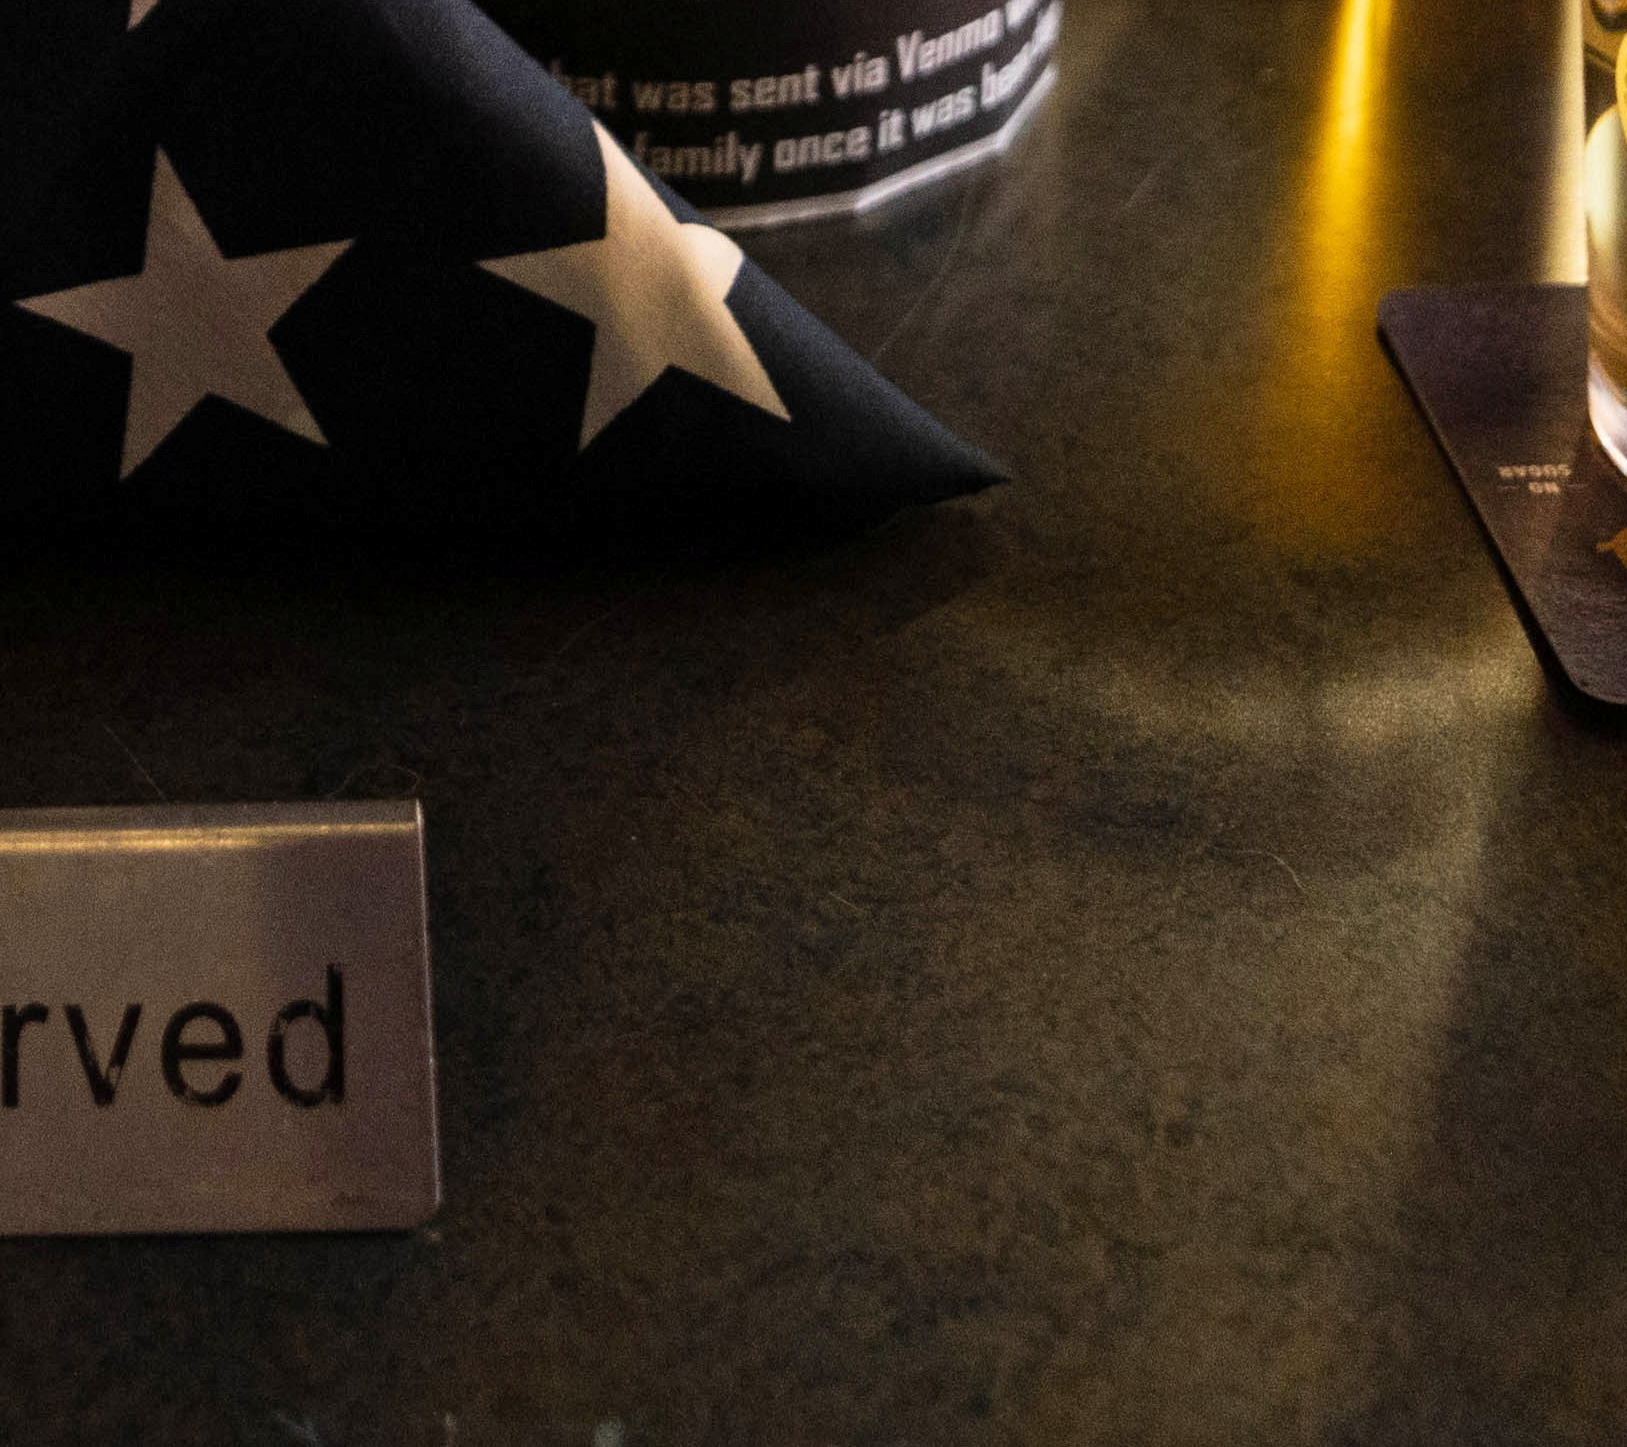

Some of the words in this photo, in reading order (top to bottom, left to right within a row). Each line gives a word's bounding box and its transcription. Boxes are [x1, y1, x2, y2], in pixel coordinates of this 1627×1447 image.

[633, 78, 720, 114] was
[730, 61, 821, 109] sent
[829, 50, 891, 102] via
[896, 6, 1006, 84] Venmo
[772, 123, 872, 173] once
[876, 107, 908, 155] it
[908, 83, 978, 140] was
